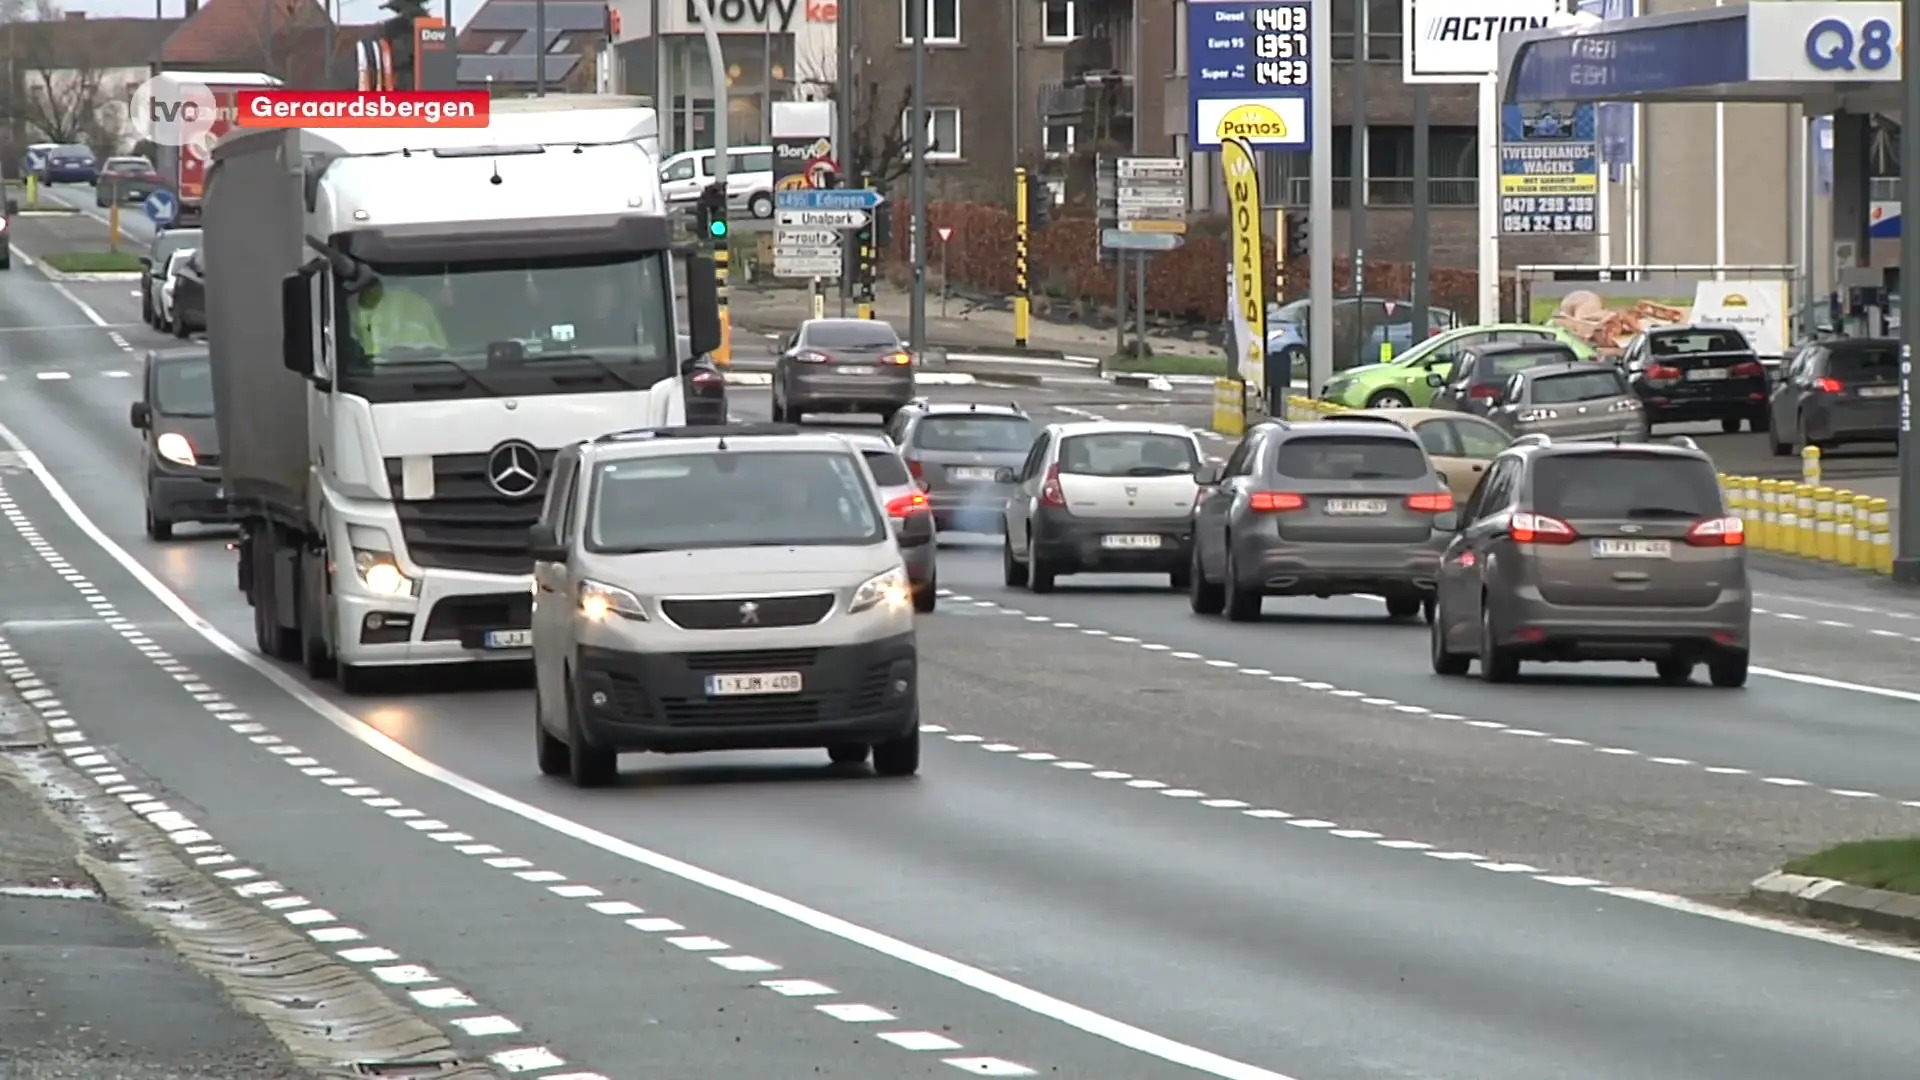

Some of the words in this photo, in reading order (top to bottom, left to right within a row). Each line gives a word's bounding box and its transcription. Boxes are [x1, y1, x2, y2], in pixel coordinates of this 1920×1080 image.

[1215, 11, 1245, 21] Diesel
[1208, 38, 1230, 48] Euro
[1232, 38, 1245, 48] 95
[1805, 19, 1892, 71] Q8
[1201, 68, 1229, 80] Super
[1224, 121, 1280, 134] Panos
[1524, 160, 1575, 173] WAGENS
[816, 191, 865, 208] Edingen
[802, 212, 854, 225] Unalpark
[1534, 215, 1551, 231] 32
[1575, 215, 1593, 231] 40
[778, 231, 828, 243] P-route
